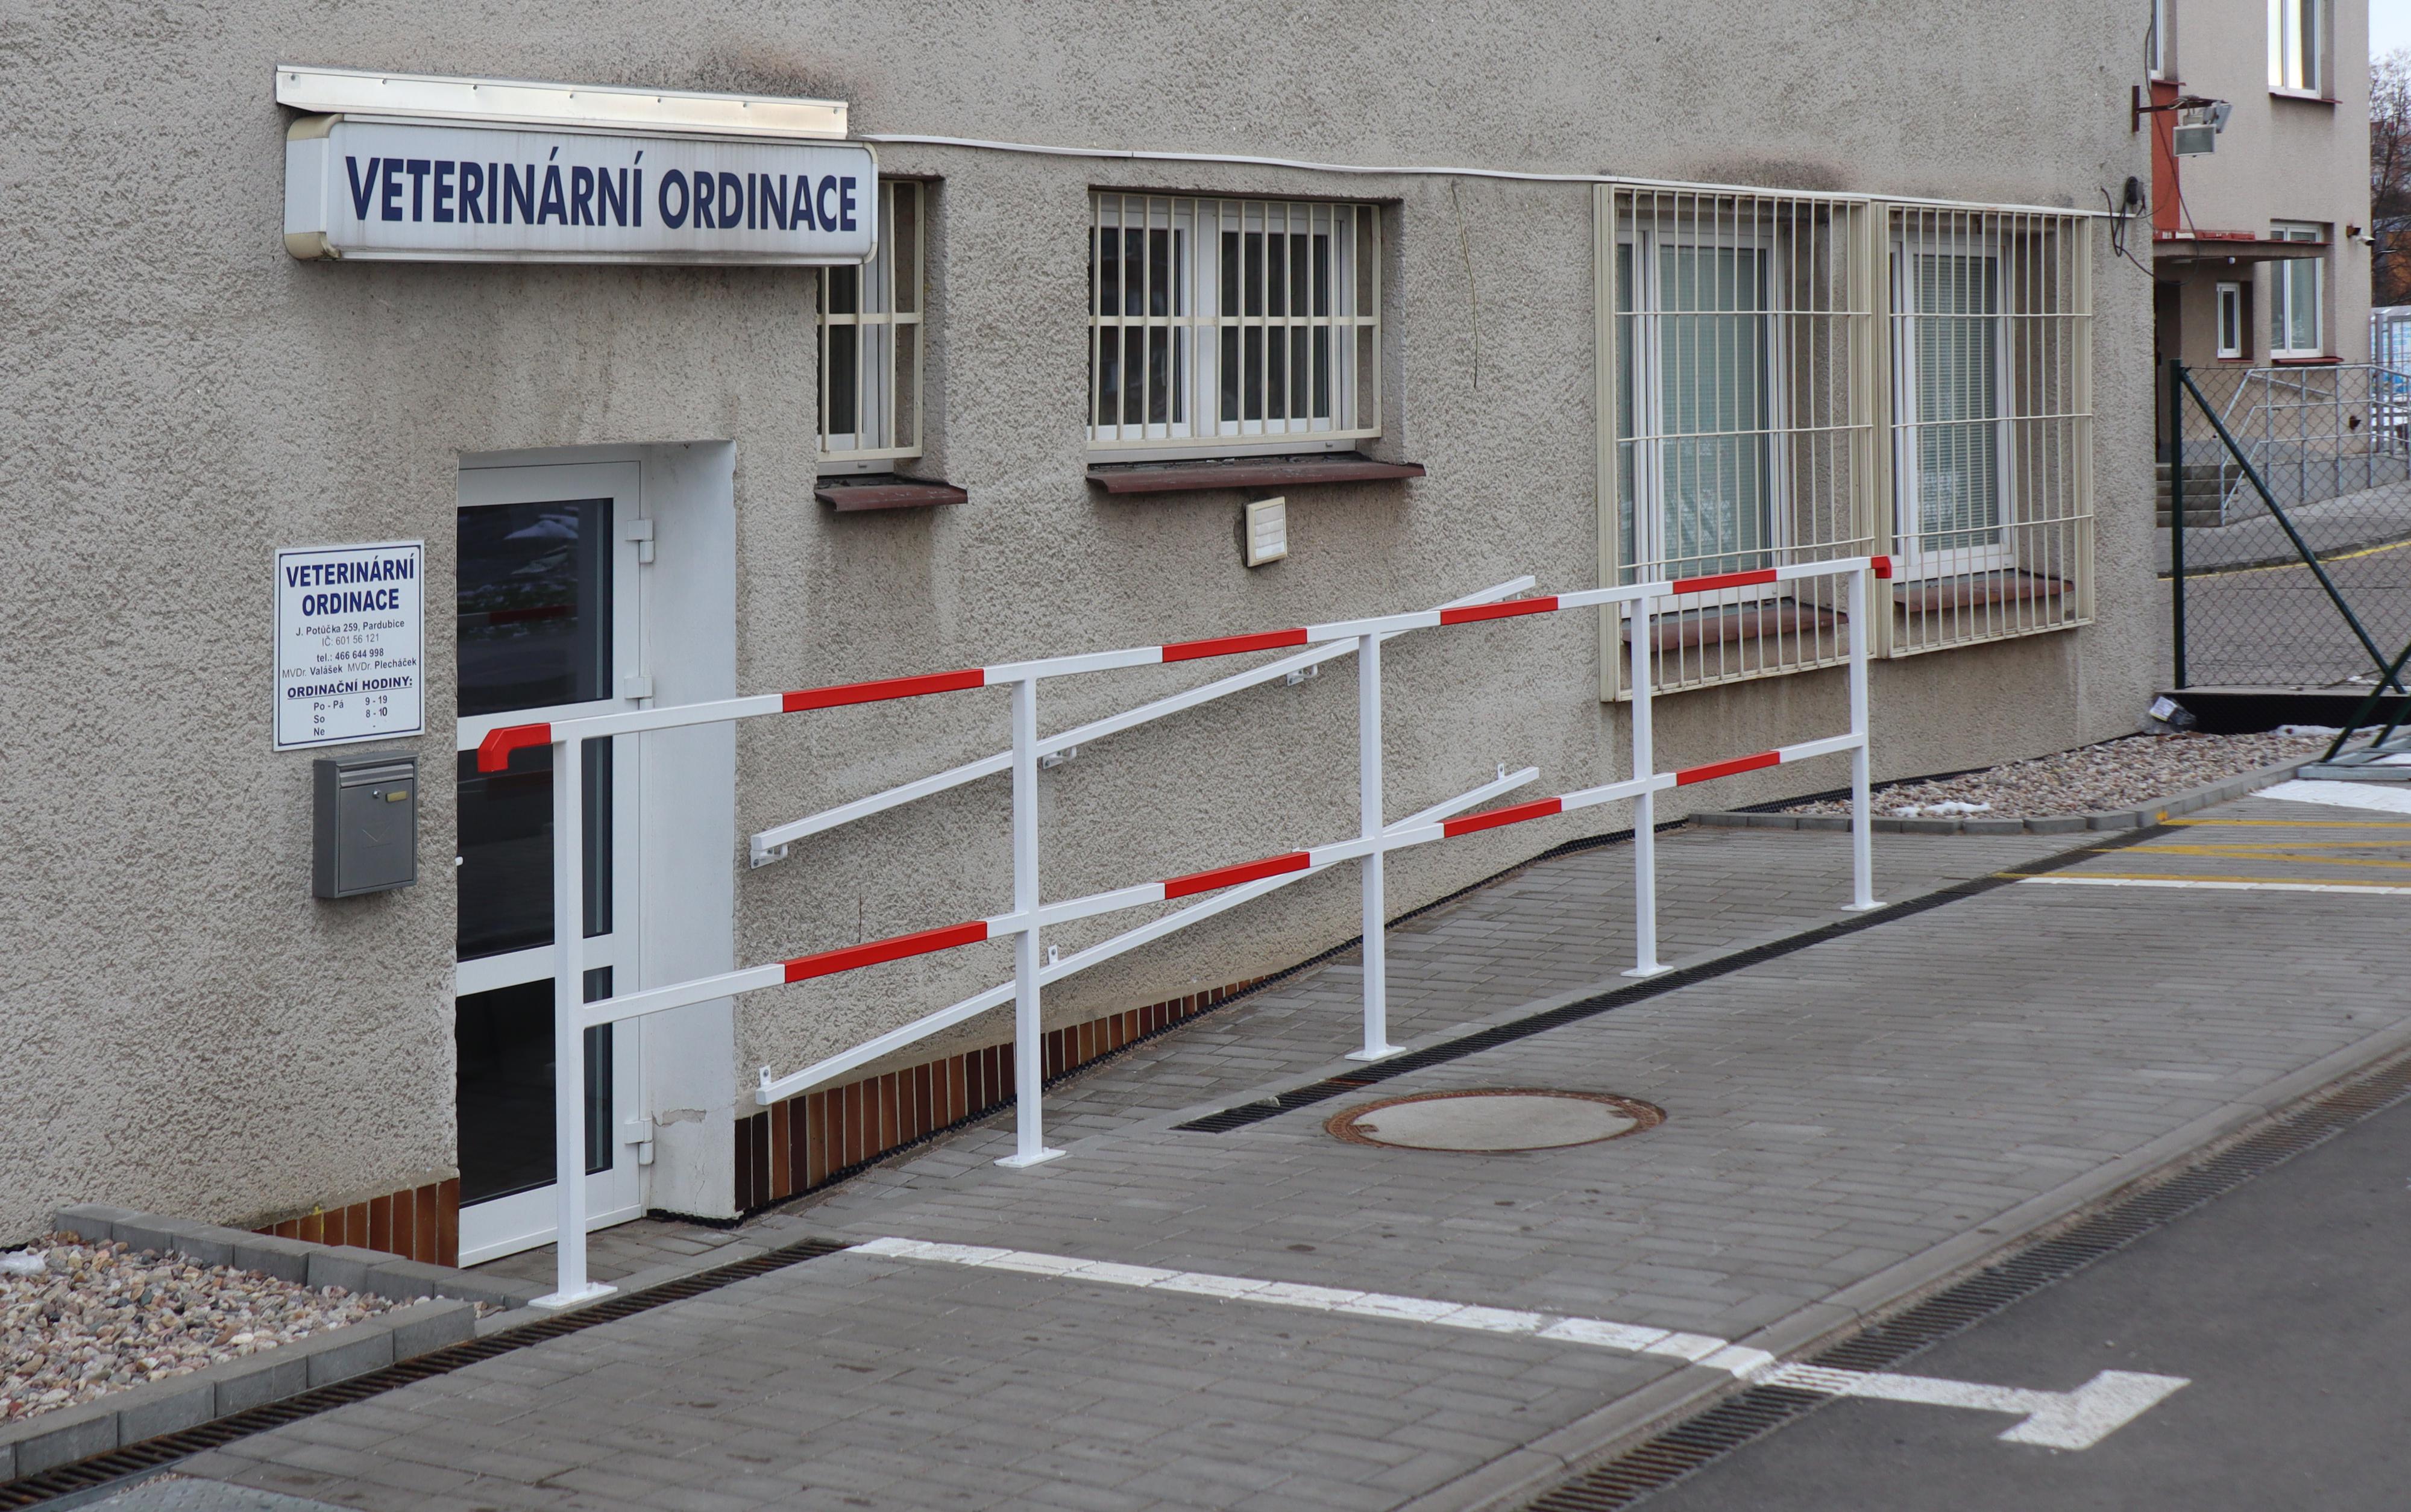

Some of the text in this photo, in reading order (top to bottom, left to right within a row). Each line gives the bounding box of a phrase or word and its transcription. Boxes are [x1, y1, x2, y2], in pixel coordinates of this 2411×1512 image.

[345, 146, 857, 232] VETERINÁRNÍ ORDINACE
[286, 553, 415, 588] VETERINÁRNÍ
[302, 588, 400, 616] ORDINACE
[296, 627, 303, 636] J.
[343, 623, 360, 632] 259,
[363, 619, 405, 630] Pardubice
[335, 636, 350, 645] 601
[353, 635, 363, 644] 56
[366, 633, 379, 642] 121
[316, 648, 384, 662] tel.: 466 644 998
[282, 657, 417, 679] MVDr. Valášek MVDr. Plecháček
[288, 676, 412, 698] ORDINAČNÍ HODINY:
[313, 701, 325, 711] Po
[333, 699, 344, 709] Pá
[365, 697, 370, 706] 9
[379, 695, 388, 704] 19
[313, 715, 325, 724] So
[366, 709, 371, 718] 8
[379, 707, 388, 717] 10
[313, 727, 325, 736] Ne
